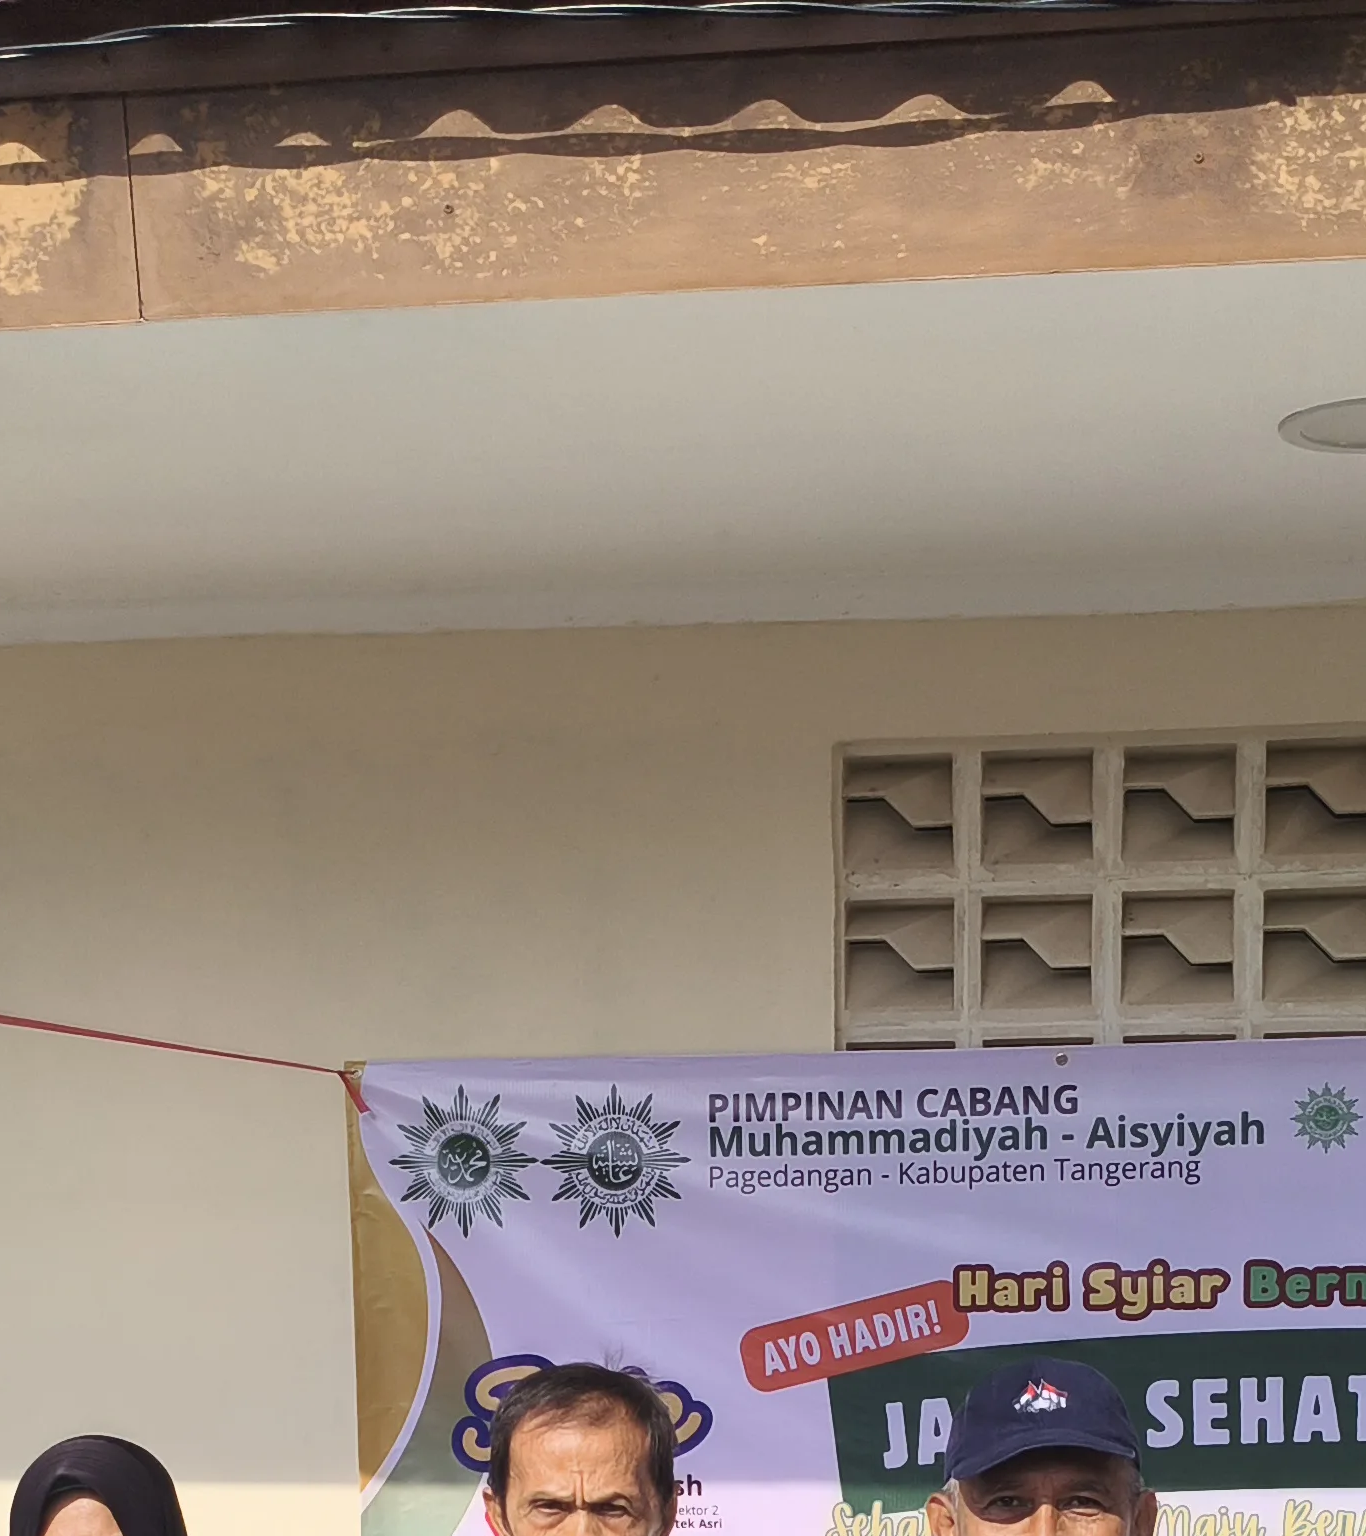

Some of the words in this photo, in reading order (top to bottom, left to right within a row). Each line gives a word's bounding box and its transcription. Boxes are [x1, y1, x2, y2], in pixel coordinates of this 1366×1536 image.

[708, 1089, 903, 1123] PIMPINAN
[914, 1085, 1079, 1118] CABANG
[708, 1121, 1050, 1162] Muhammadiyah
[1086, 1112, 1266, 1157] Aisyiyah
[708, 1162, 873, 1193] Pagedangan
[898, 1159, 1046, 1191] Kabupaten
[1055, 1155, 1201, 1189] Tangerang
[955, 1263, 1068, 1310] Hari
[1085, 1260, 1227, 1317] Syiar
[763, 1331, 822, 1376] AYO
[826, 1299, 942, 1356] HADIR!
[678, 1504, 707, 1516] ektor
[698, 1517, 723, 1530] Asri
